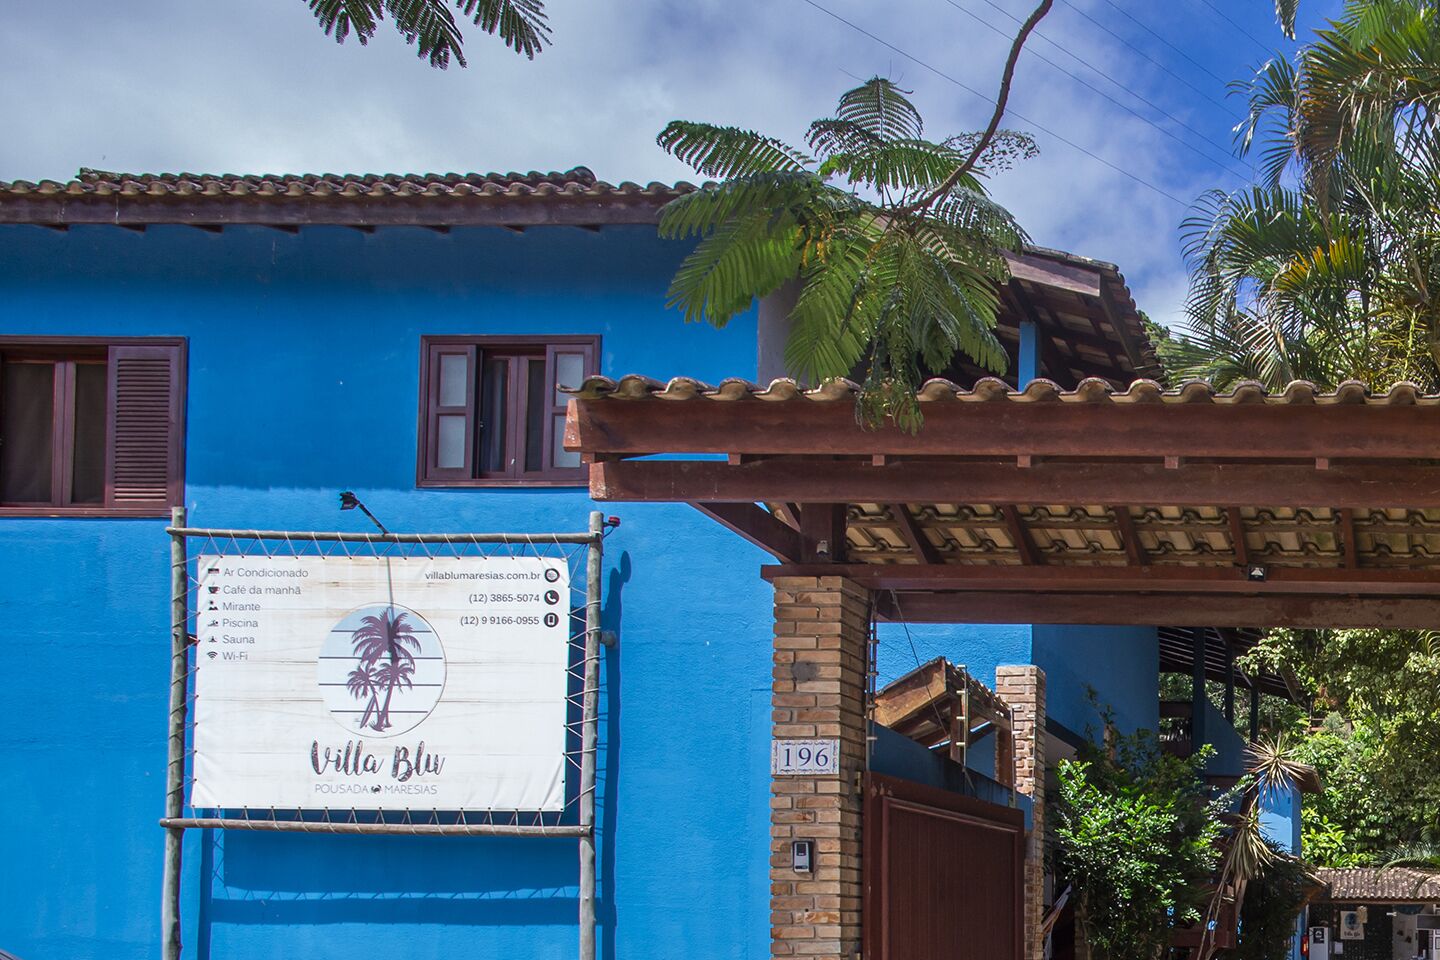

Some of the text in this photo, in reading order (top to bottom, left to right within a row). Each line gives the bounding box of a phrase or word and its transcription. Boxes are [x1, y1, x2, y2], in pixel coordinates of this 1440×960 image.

[224, 568, 309, 578] Ar Condicionado
[425, 571, 541, 580] villablumaresias.com.br
[223, 585, 302, 595] Café da manhã
[469, 593, 540, 604] (12) 3865-5074
[222, 602, 261, 611] Mirante
[222, 618, 259, 628] Piscina
[460, 616, 540, 627] (12) 9 9166-0955
[222, 634, 256, 644] Sauna
[222, 652, 249, 661] Wi-Fi
[311, 739, 446, 782] Villa Blu
[784, 747, 829, 767] 196
[315, 783, 438, 795] POUSADA MARESIAS
